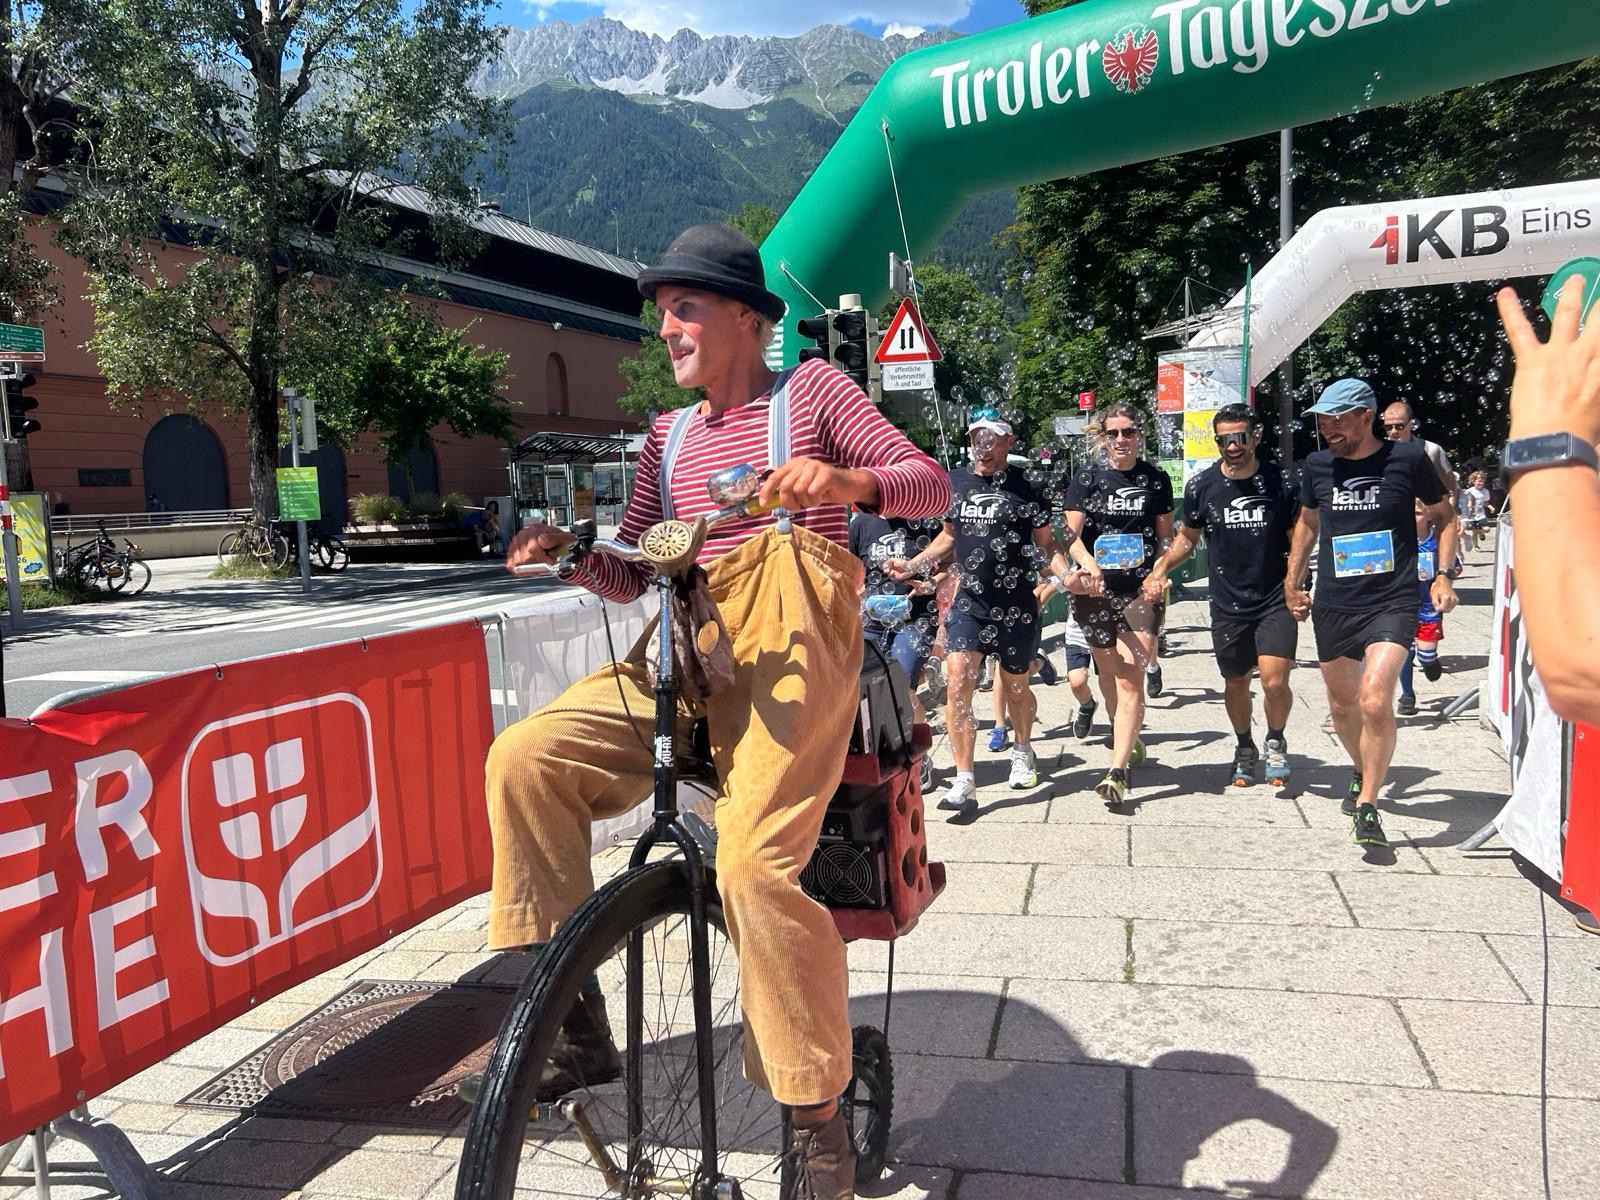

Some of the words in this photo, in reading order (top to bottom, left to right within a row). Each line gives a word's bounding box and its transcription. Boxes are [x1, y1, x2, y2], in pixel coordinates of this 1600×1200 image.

[929, 39, 1100, 129] Tiroler
[1522, 206, 1592, 234] Eins
[1084, 396, 1091, 404] S
[1107, 495, 1146, 511] lauf
[1332, 486, 1380, 505] lauf
[960, 501, 999, 518] lauf
[1223, 504, 1266, 524] lauf
[870, 541, 906, 557] lauf
